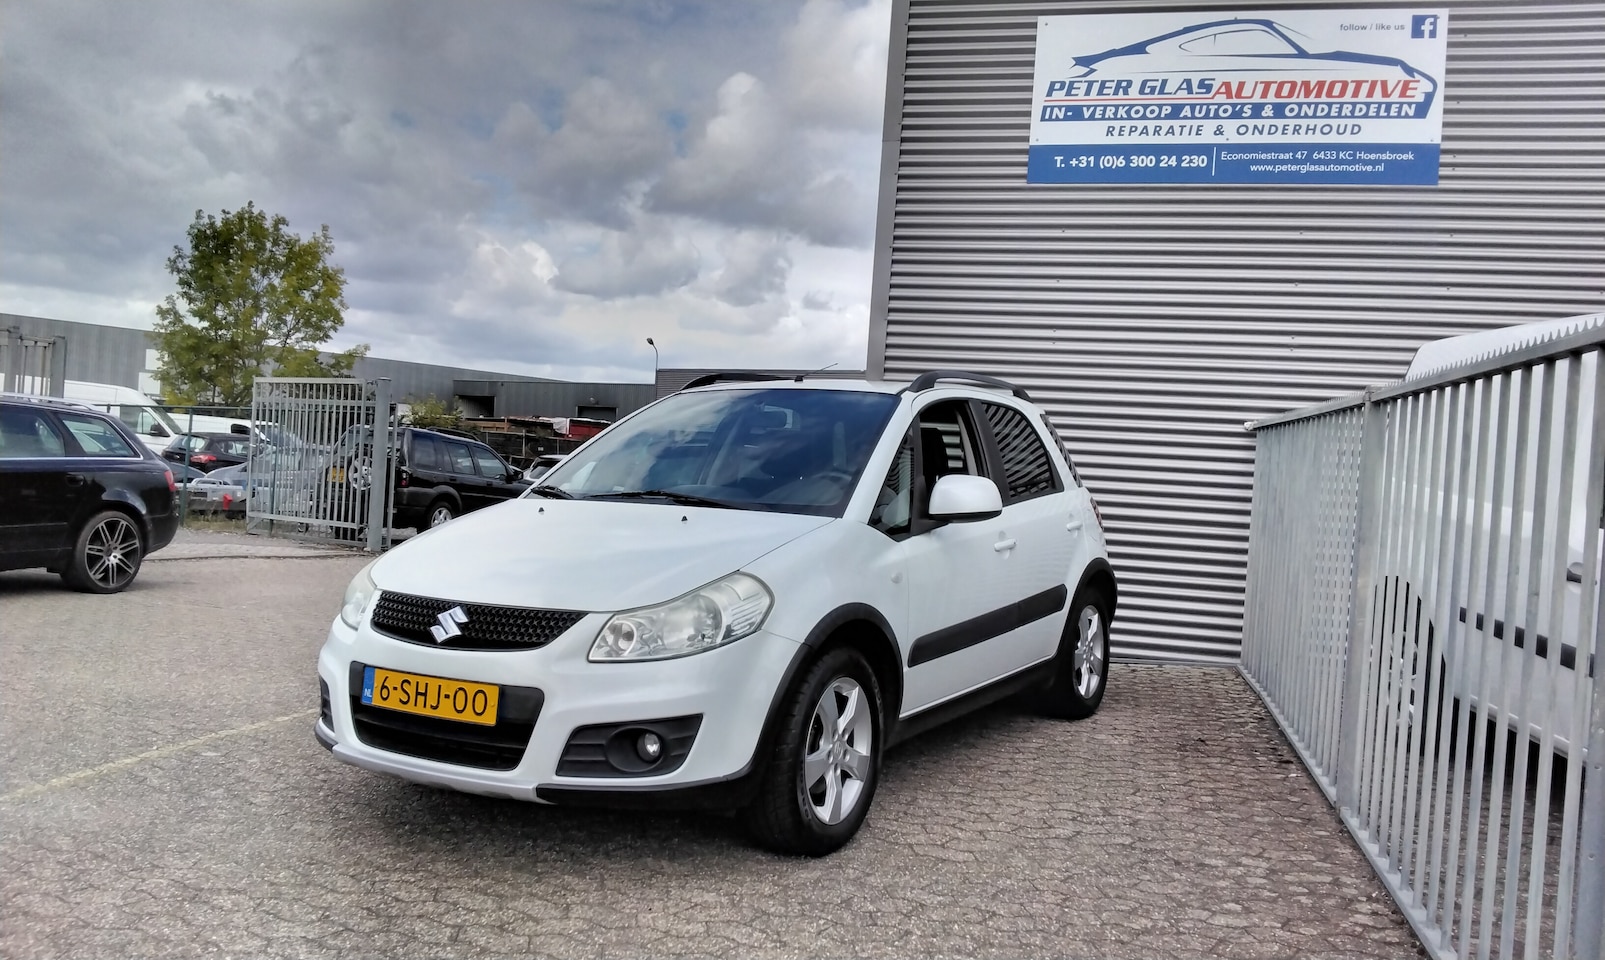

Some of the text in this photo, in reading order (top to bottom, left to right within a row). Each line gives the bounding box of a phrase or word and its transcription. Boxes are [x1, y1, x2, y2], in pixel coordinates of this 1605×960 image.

[1045, 78, 1420, 100] PETER GLAS AUTOMOTIVE
[1044, 104, 1416, 119] IN- VERKOOP AUTO'S & ONDERDELEN
[1105, 124, 1362, 137] REPARATIE & ONDERHOUD
[1221, 150, 1414, 160] Economiestraat 47 6433 KC Hoensbroek
[1054, 156, 1208, 169] T. +31 (0)6 300 24 230
[1250, 162, 1385, 173] www.peterglasautomotive.nl
[364, 688, 372, 698] NL
[379, 676, 488, 716] 6-SHJ-00
